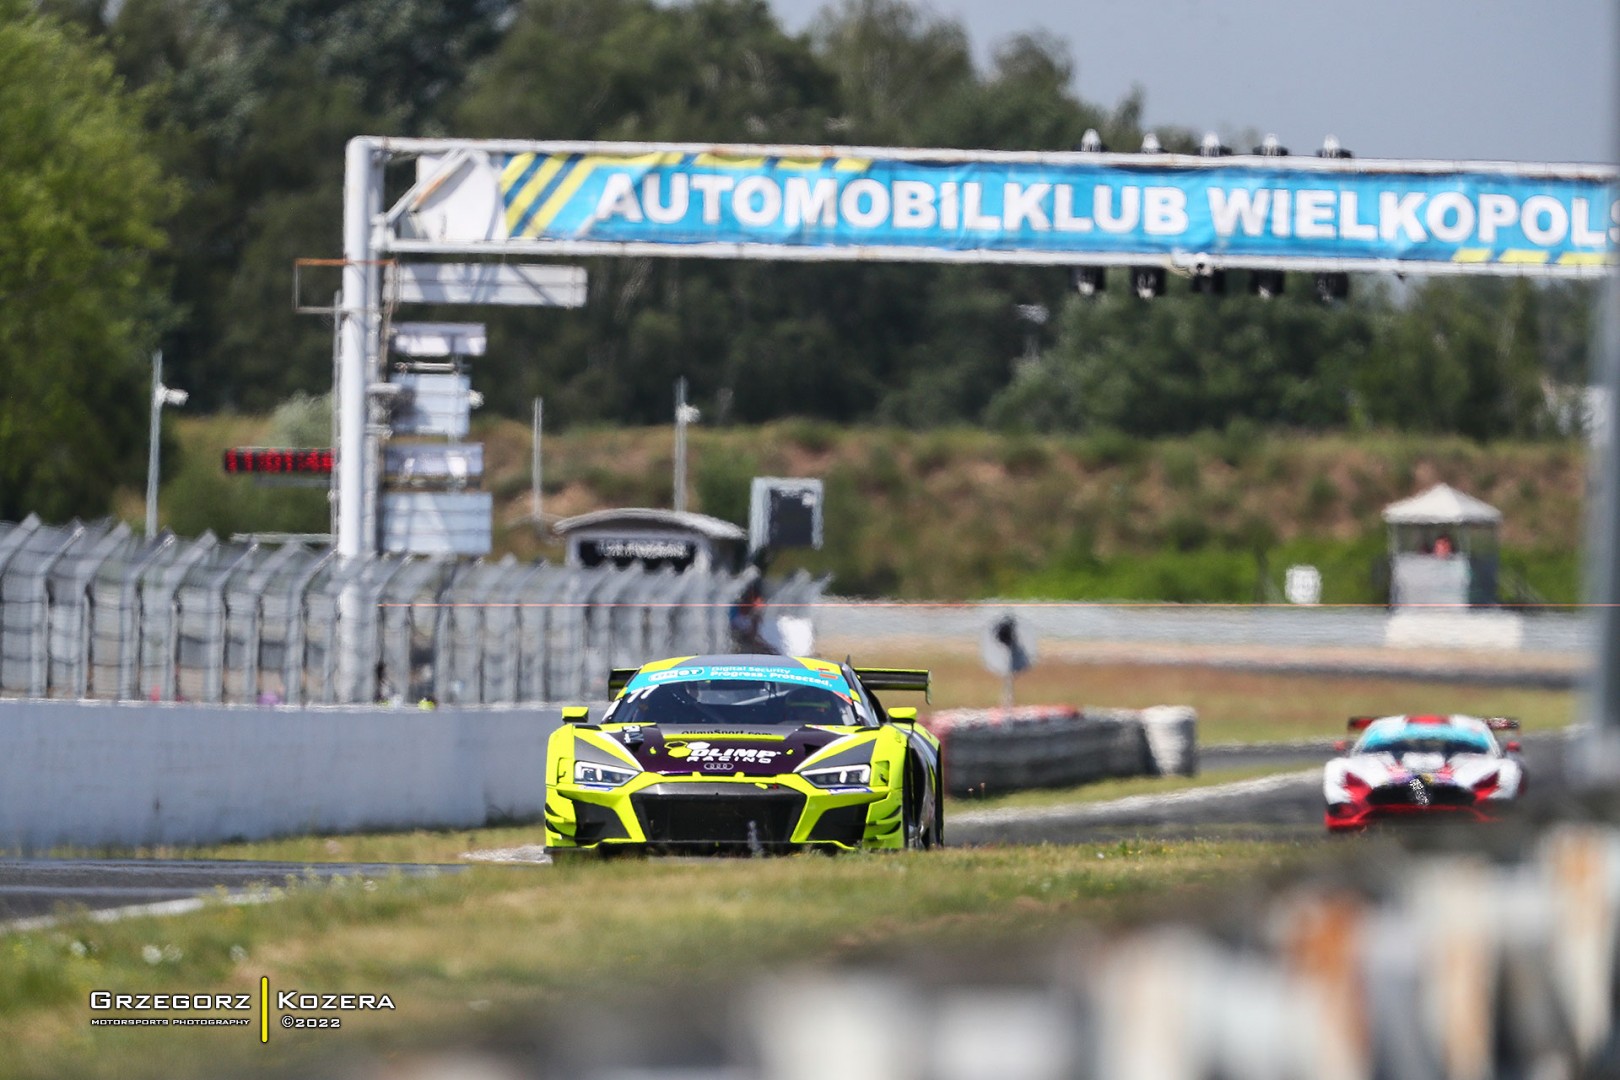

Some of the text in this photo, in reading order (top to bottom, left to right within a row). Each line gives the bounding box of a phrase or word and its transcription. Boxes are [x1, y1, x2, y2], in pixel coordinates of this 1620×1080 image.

[595, 172, 1188, 235] AUTOMOBILKLUB
[711, 665, 791, 675] Digital Security
[770, 672, 833, 687] Protected.
[690, 748, 777, 759] OLIMP
